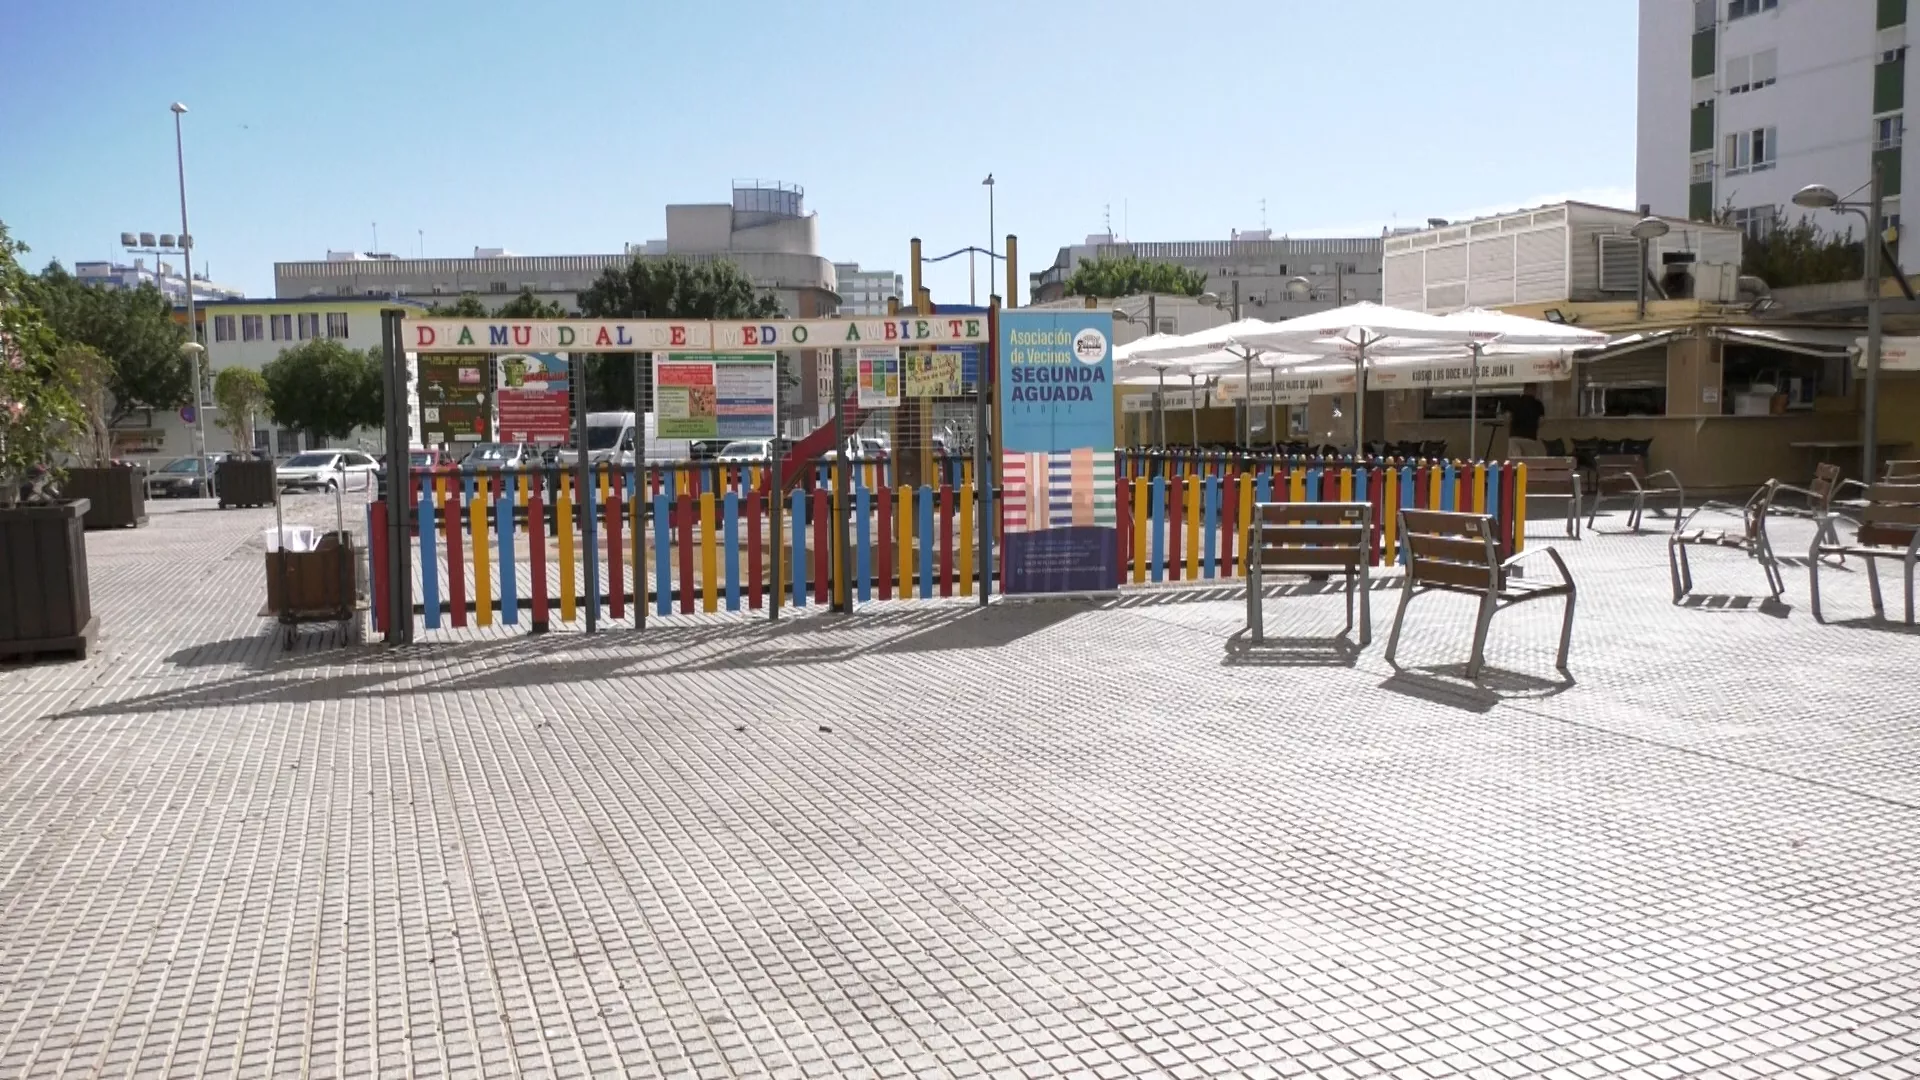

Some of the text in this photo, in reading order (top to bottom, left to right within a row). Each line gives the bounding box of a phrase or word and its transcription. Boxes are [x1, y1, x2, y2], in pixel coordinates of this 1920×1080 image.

[416, 319, 980, 347] DIA MUNDIAL DEL MEDIO AMBIENTE
[1010, 328, 1072, 345] Asociación
[1010, 348, 1072, 365] de Vecinos
[1011, 366, 1106, 383] SEGUNDA
[1481, 366, 1490, 378] DE
[1491, 364, 1508, 377] JUAN
[1011, 386, 1094, 402] AGUADA
